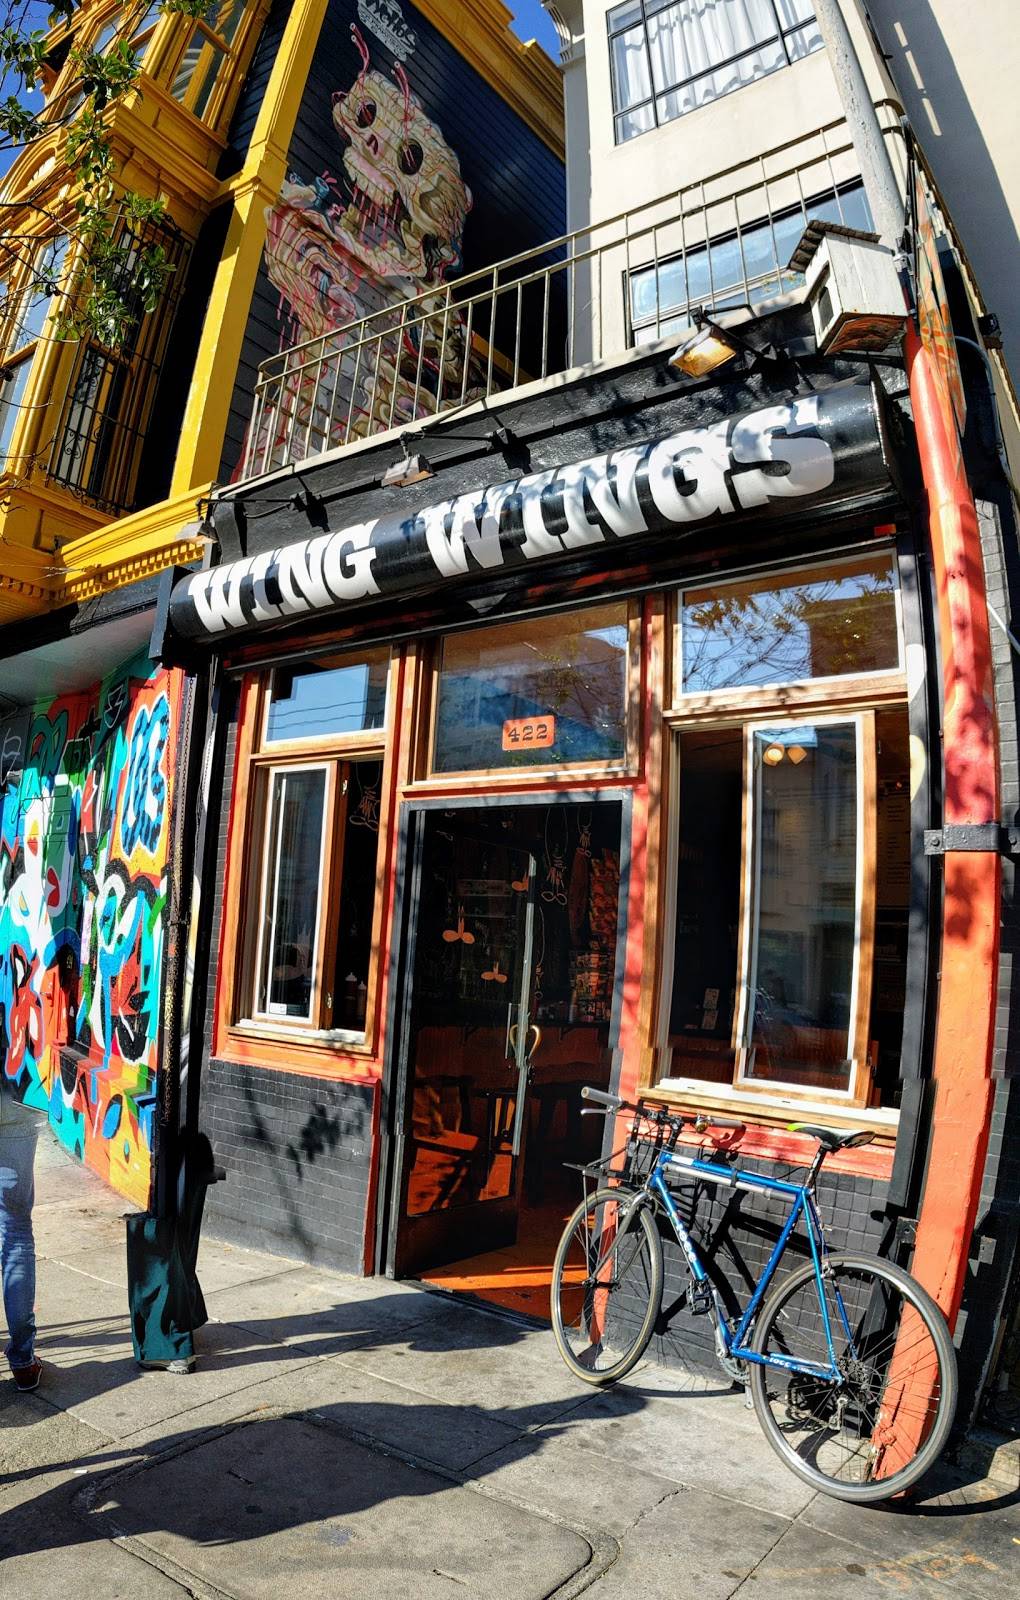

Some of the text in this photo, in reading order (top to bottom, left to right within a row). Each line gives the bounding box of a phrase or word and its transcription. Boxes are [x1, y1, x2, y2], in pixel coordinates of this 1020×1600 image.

[188, 394, 835, 633] WING WINGS
[508, 723, 547, 742] 422
